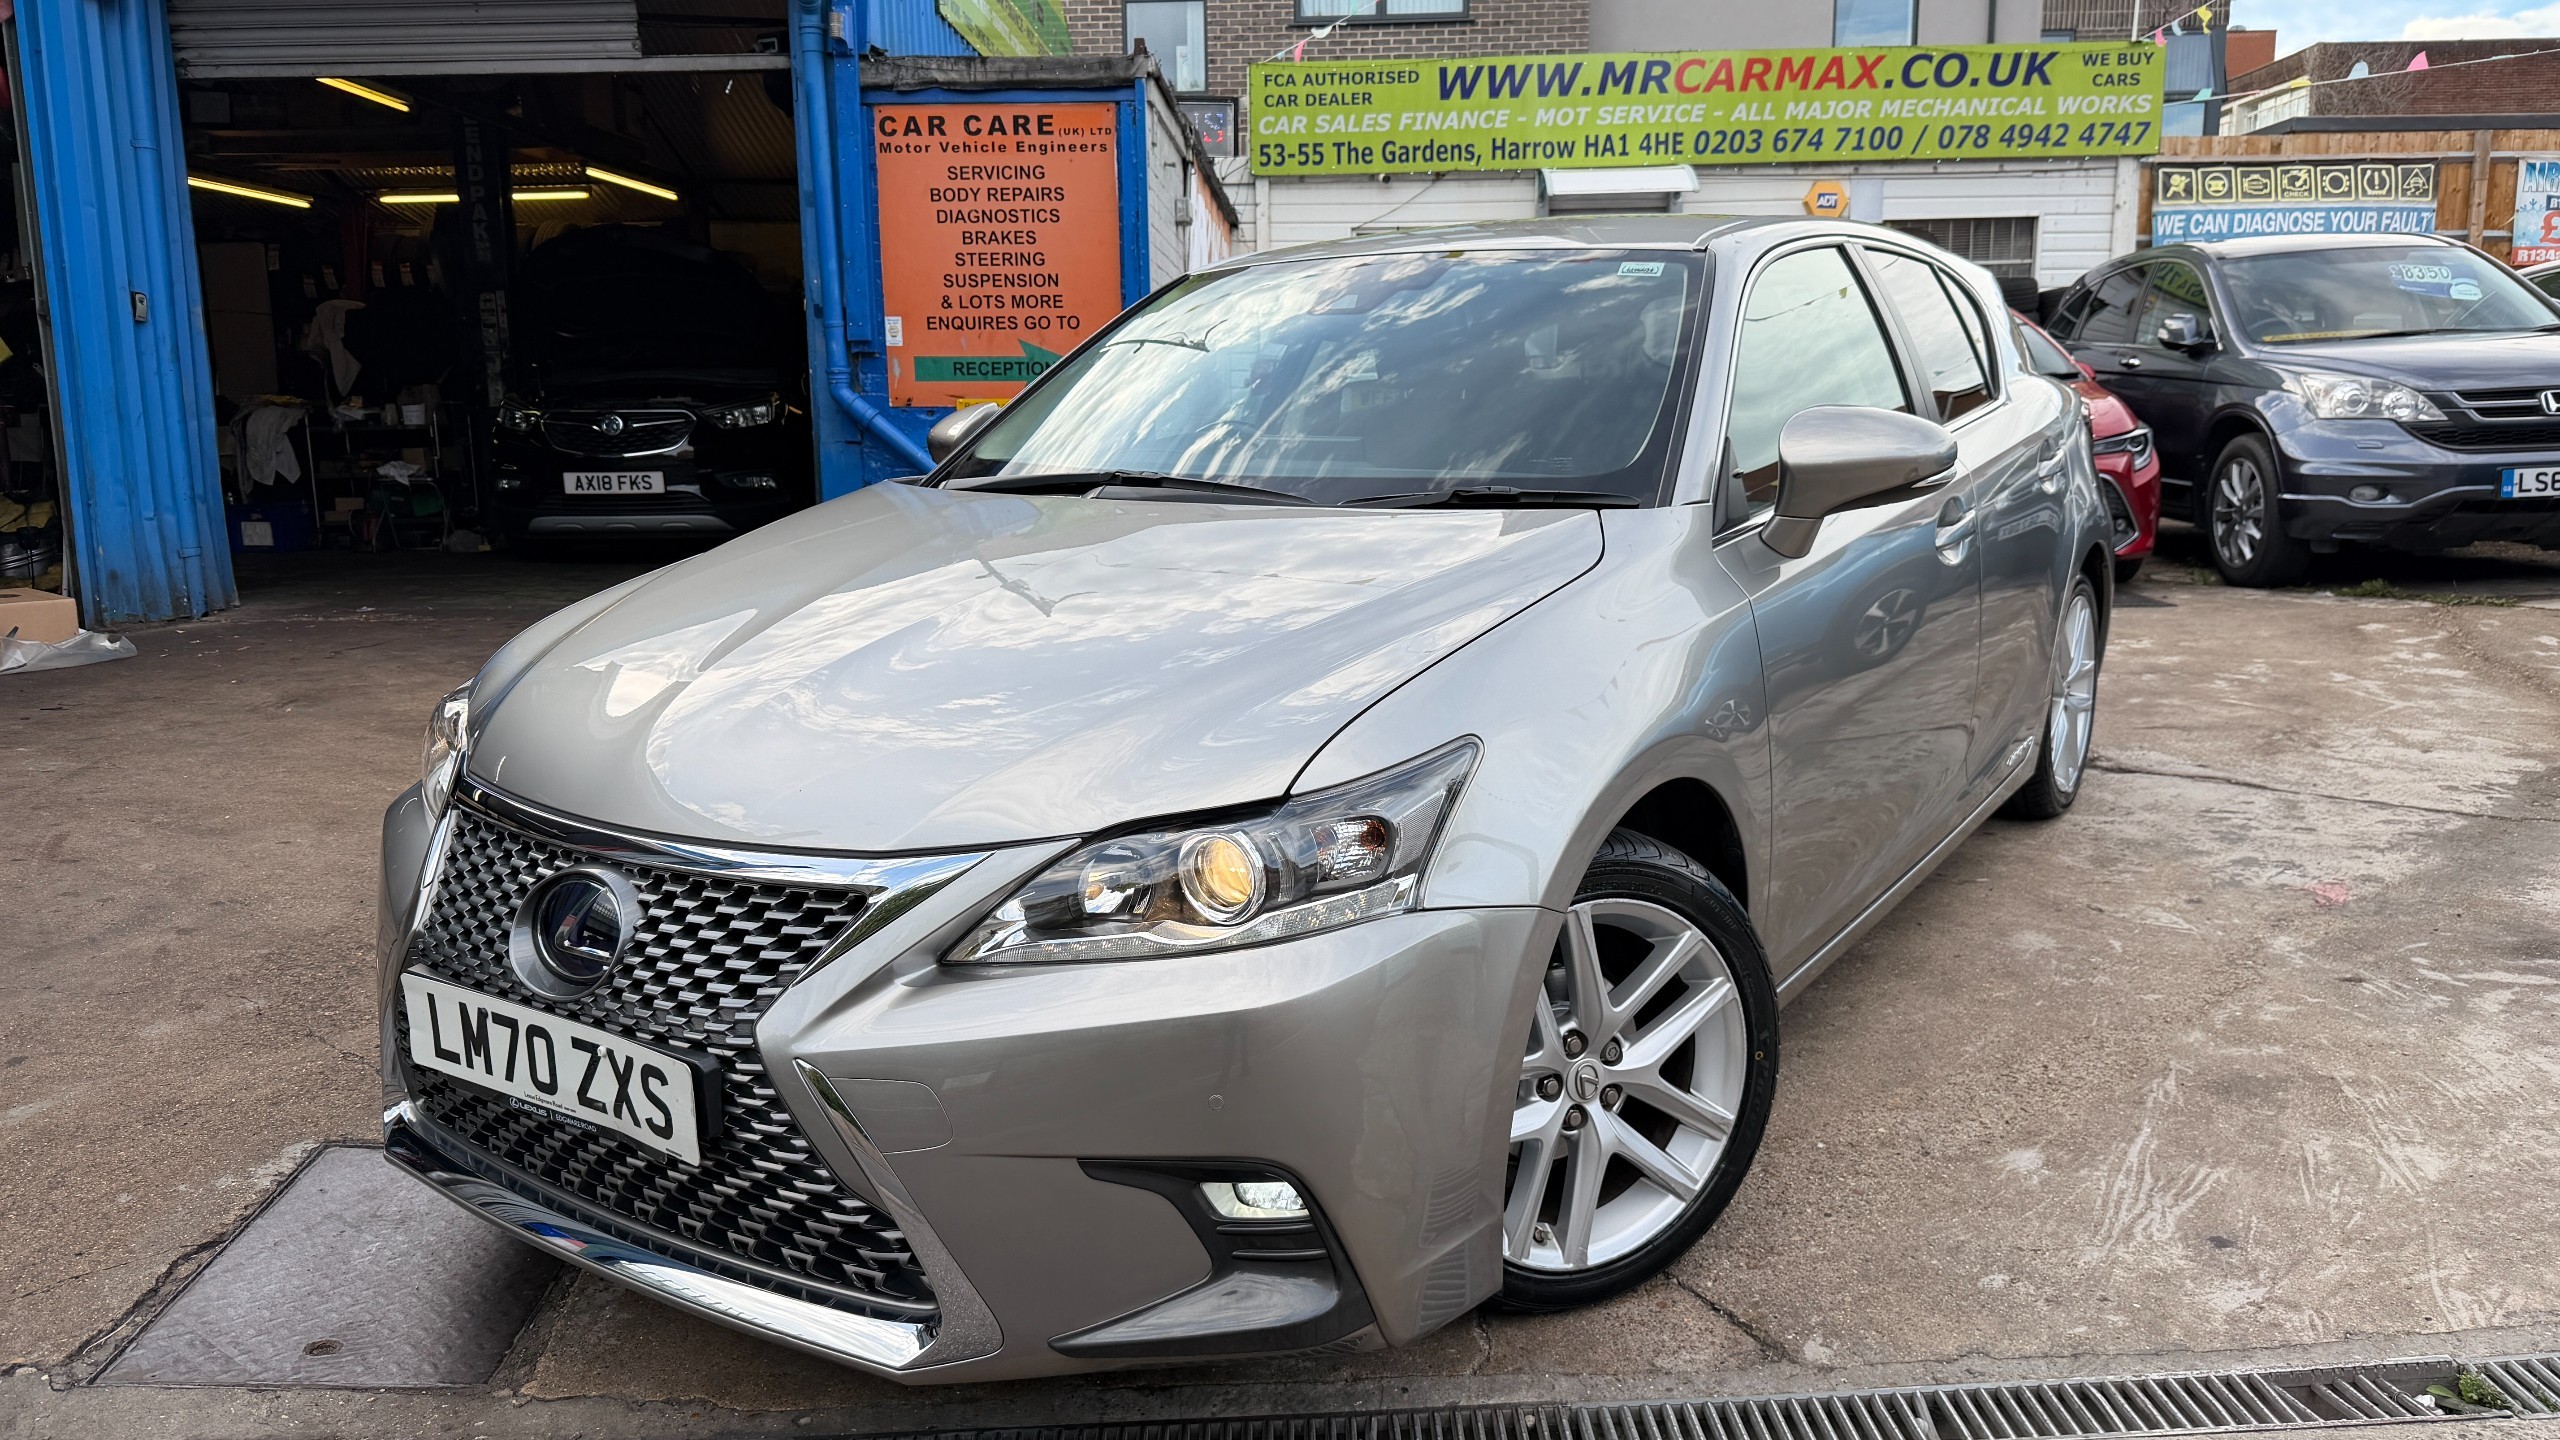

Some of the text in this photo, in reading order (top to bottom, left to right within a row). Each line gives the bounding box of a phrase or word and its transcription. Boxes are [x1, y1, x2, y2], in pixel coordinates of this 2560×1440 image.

[2082, 52, 2155, 68] WE BUY
[1264, 70, 1419, 87] FCA AUTHORISED
[1438, 51, 2059, 101] WWW.MRCARMAX.CO.UK
[2092, 72, 2141, 87] CARS
[1264, 92, 1372, 107] CAR DEALER
[1259, 115, 1306, 135] CAR
[1314, 113, 1391, 133] SALES
[1399, 109, 1508, 131] FINANCE
[1535, 107, 1589, 127] MOT
[1596, 104, 1706, 125] SERVICE
[1731, 101, 1775, 121] ALL
[1784, 99, 1870, 119] MAJOR
[1879, 97, 2047, 117] MECHANICAL
[2056, 93, 2153, 114] WORKS
[878, 114, 1112, 138] CAR CARE (UK) LTD
[879, 141, 1108, 155] Motor Vehicle Engineers
[1259, 121, 2151, 167] 53-55 The Gardens, Harrow HA1 4HE 0203 674 7100 / 078 4942 4747
[947, 165, 1045, 180] SERVICING
[930, 186, 1065, 202] BODY REPAIRS
[1817, 194, 1838, 208] ADT
[2283, 190, 2310, 198] CHECK
[936, 208, 1060, 223] DIAGNOSTICS
[2157, 210, 2433, 235] WE CAN DIAGNOSE YOUR FAULT
[962, 231, 1037, 245] BRAKES
[955, 252, 1045, 266] STEERING
[943, 273, 1059, 288] SUSPENSION
[941, 294, 1063, 309] & LOTS MORE
[927, 315, 1080, 331] ENQUIRES GO TO
[575, 474, 653, 491] AX18 FKS
[426, 991, 674, 1141] LM70 ZXS
[520, 1102, 548, 1116] LEXUS
